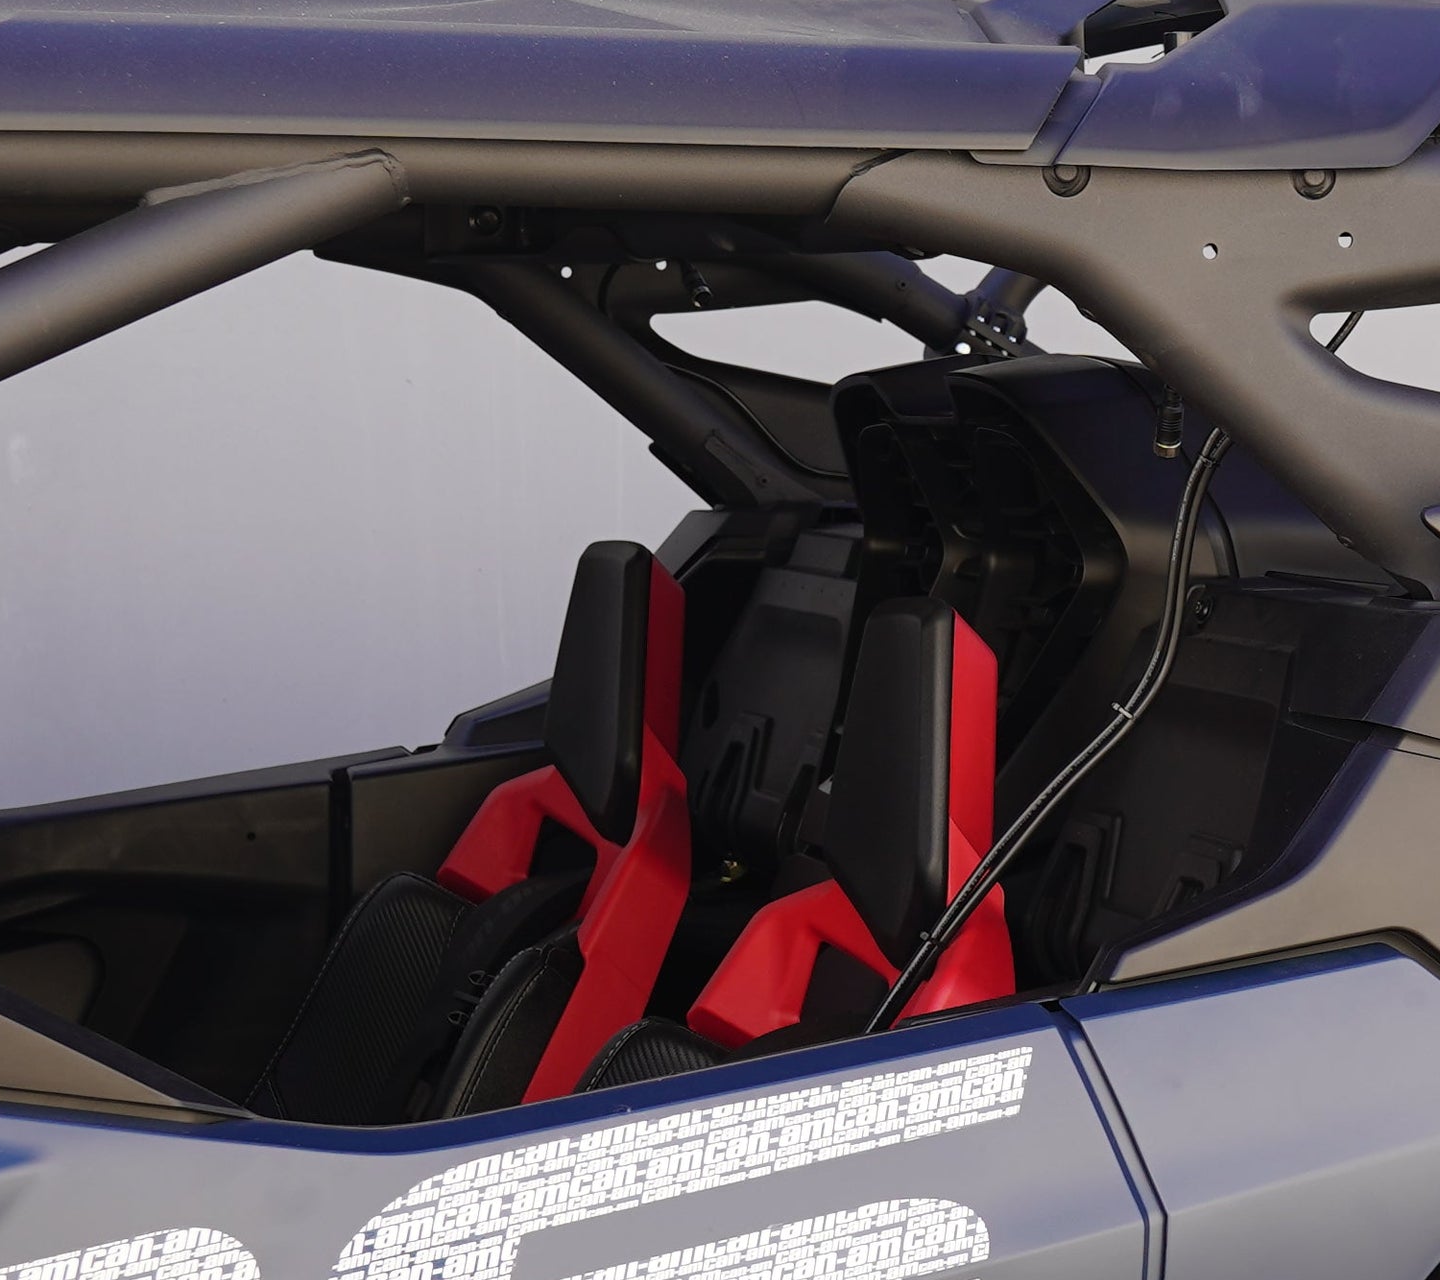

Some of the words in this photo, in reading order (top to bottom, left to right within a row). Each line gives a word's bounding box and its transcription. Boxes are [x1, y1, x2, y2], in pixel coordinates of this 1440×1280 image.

[439, 1181, 570, 1227] can-am
[569, 1149, 702, 1197] can-am
[702, 1118, 835, 1164] can-am
[833, 1085, 961, 1131] can-am
